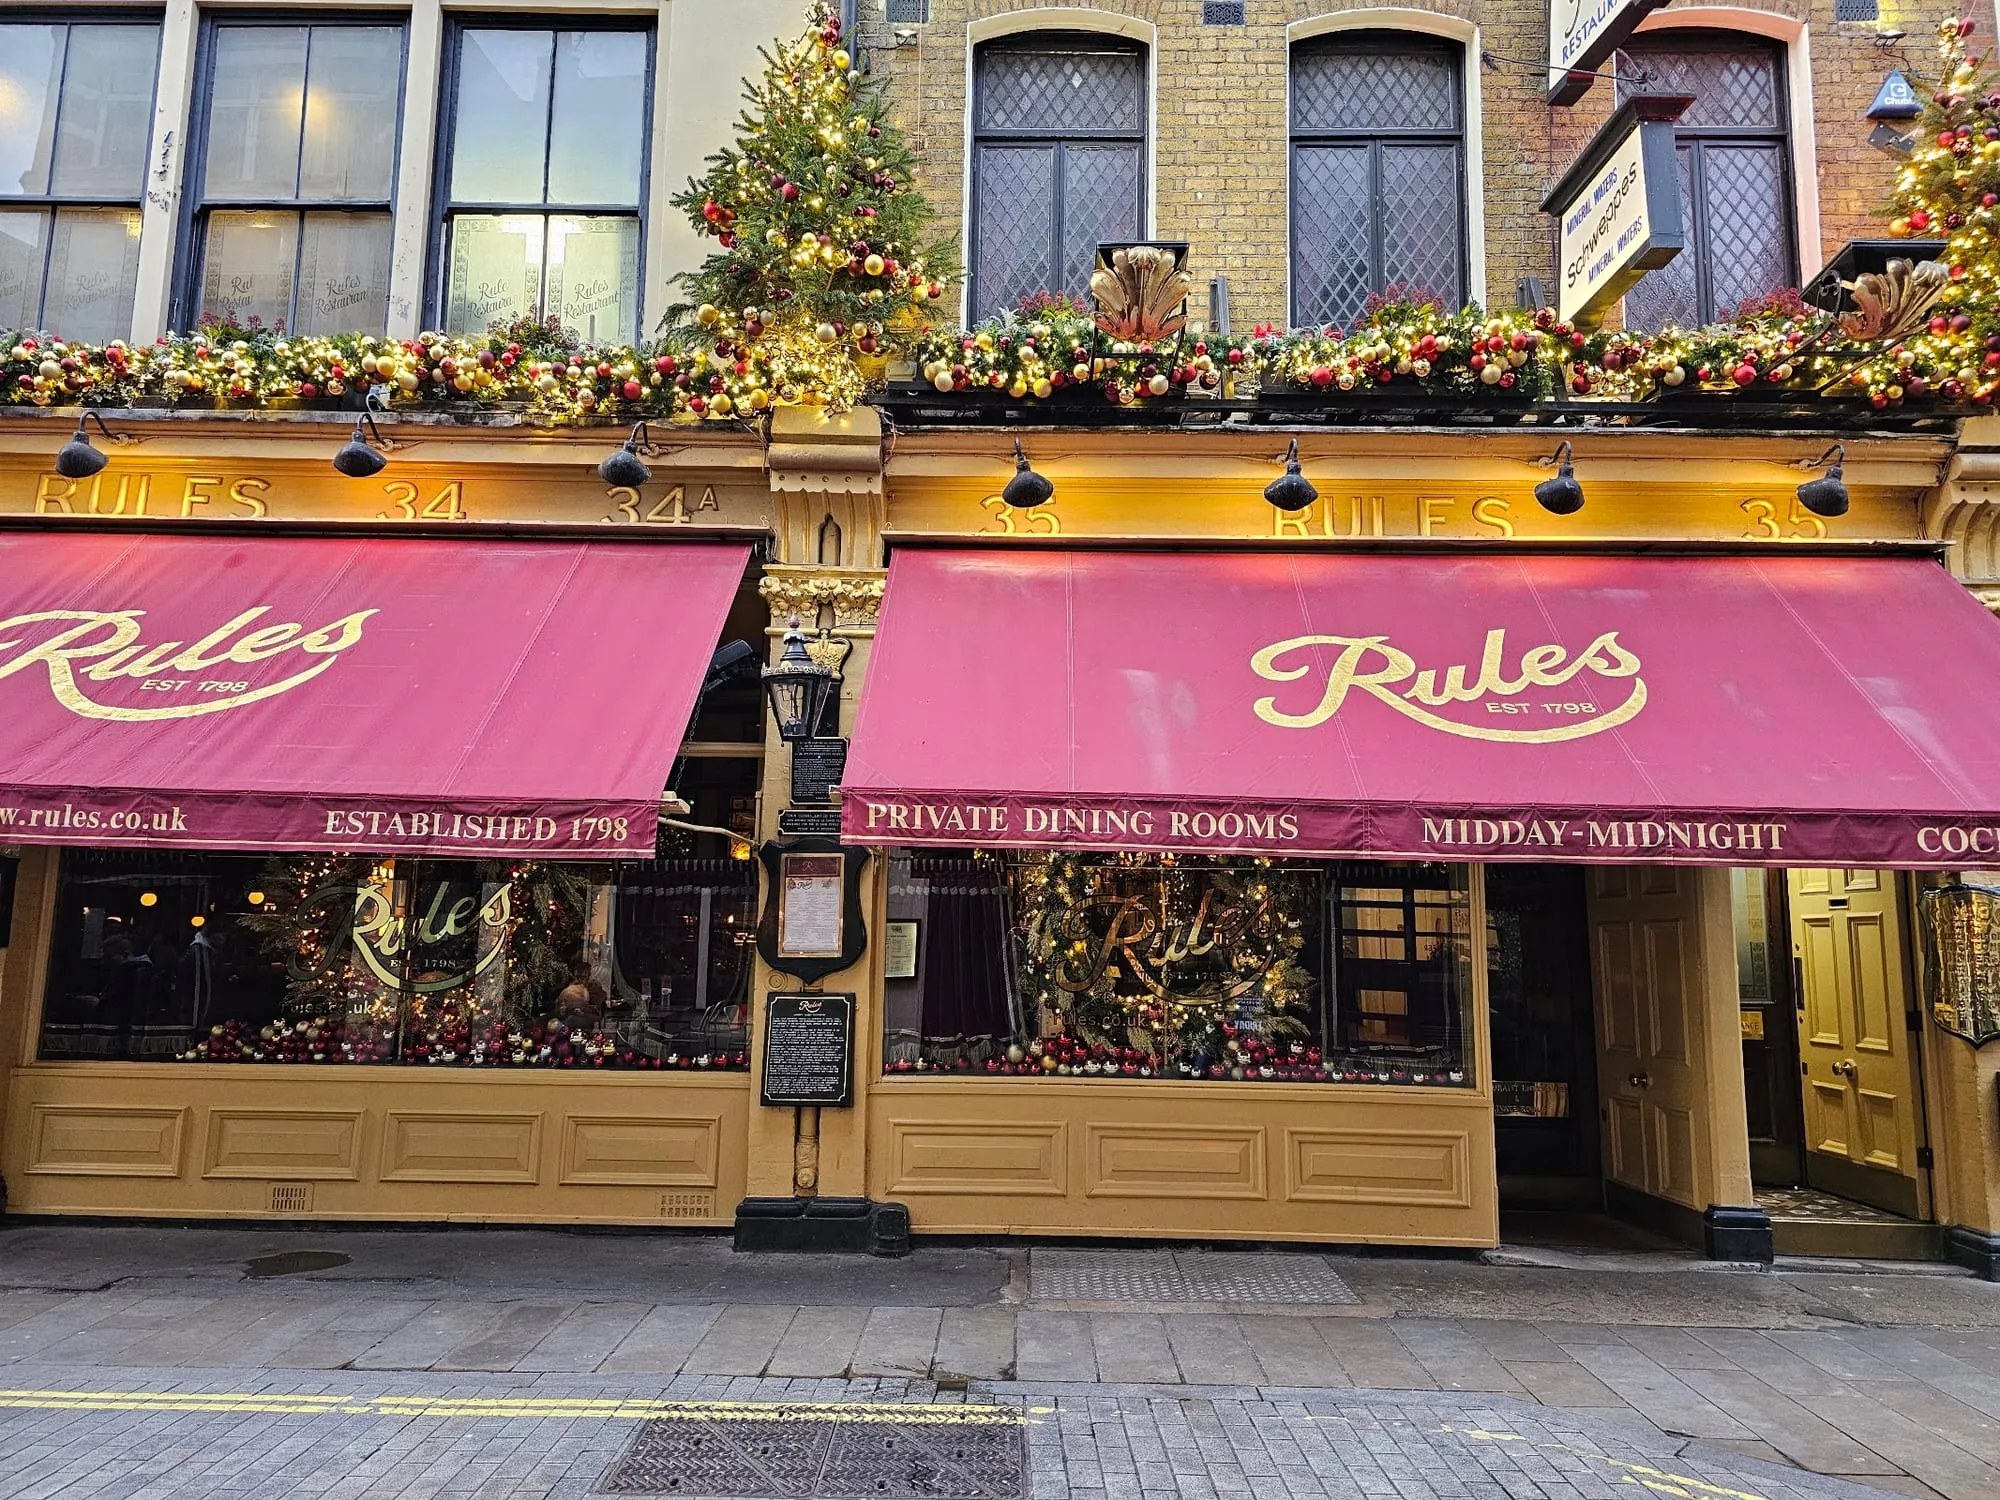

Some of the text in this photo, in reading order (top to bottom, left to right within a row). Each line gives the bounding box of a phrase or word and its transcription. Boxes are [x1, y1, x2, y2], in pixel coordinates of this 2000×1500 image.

[1566, 166, 1619, 237] MINERAL WATERS
[1567, 161, 1638, 288] Schweppes
[1588, 215, 1643, 284] MINERAL WATERS
[231, 273, 255, 296] Rul
[326, 274, 361, 297] Rules
[478, 278, 509, 301] Rule
[574, 279, 609, 302] Rules
[467, 295, 522, 322] Restauran
[563, 290, 623, 322] Restaurant
[375, 481, 467, 520] 34
[979, 494, 1061, 535] 35
[1740, 498, 1829, 539] 35
[0, 606, 381, 722] Rules
[140, 679, 249, 693] EST 1798
[1250, 628, 1648, 744] Rules
[1486, 702, 1597, 715] EST 1798
[323, 810, 629, 842] ESTABLISHED 1798
[866, 803, 1008, 832] PRIVATE
[1024, 807, 1154, 836] DINING
[1169, 811, 1299, 840] ROOMS
[1422, 817, 1787, 851] MIDDAY-MIDNIGHT
[287, 881, 512, 992] Rules
[1055, 887, 1282, 1006] Rules
[424, 959, 456, 968] 1798
[1053, 1013, 1148, 1027] rules.co.uk
